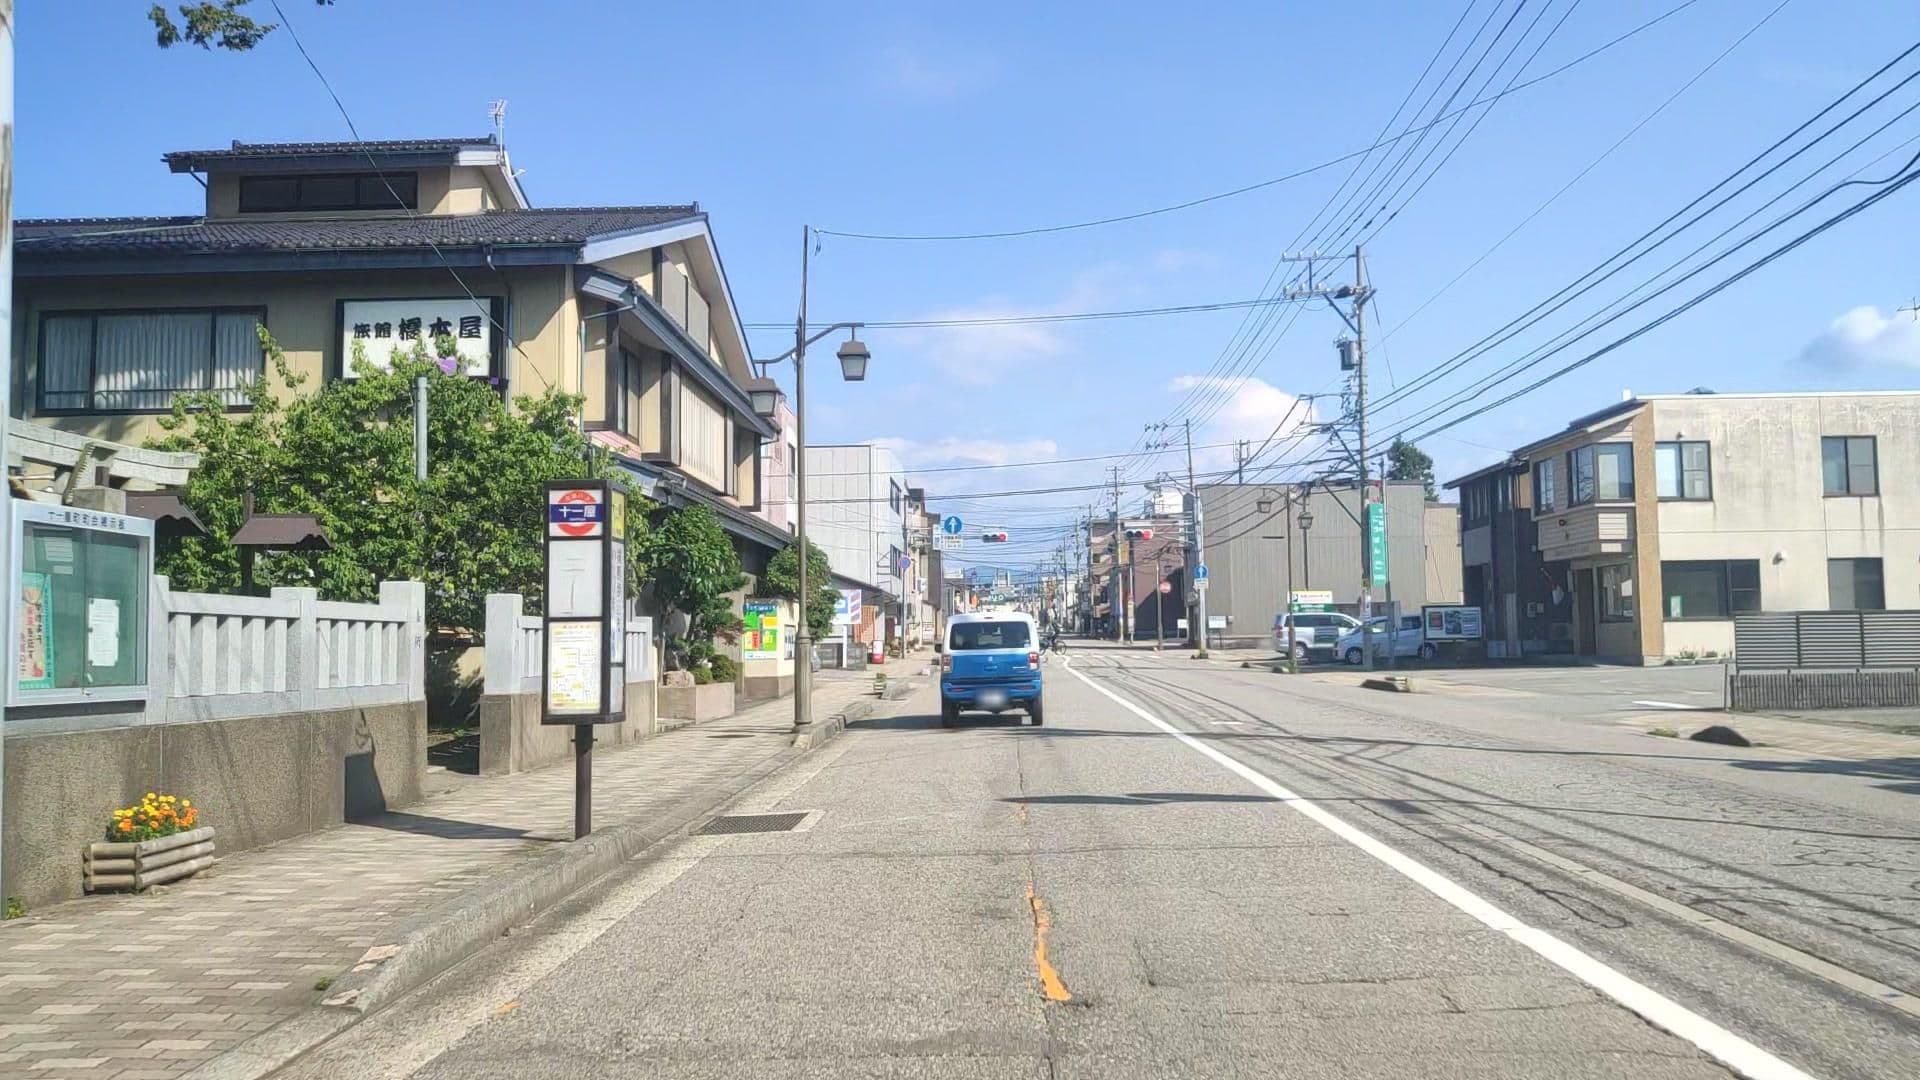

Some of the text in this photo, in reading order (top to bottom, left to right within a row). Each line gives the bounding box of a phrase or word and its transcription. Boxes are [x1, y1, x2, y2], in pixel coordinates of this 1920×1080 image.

[47, 511, 125, 530] 十一町町会掲示板
